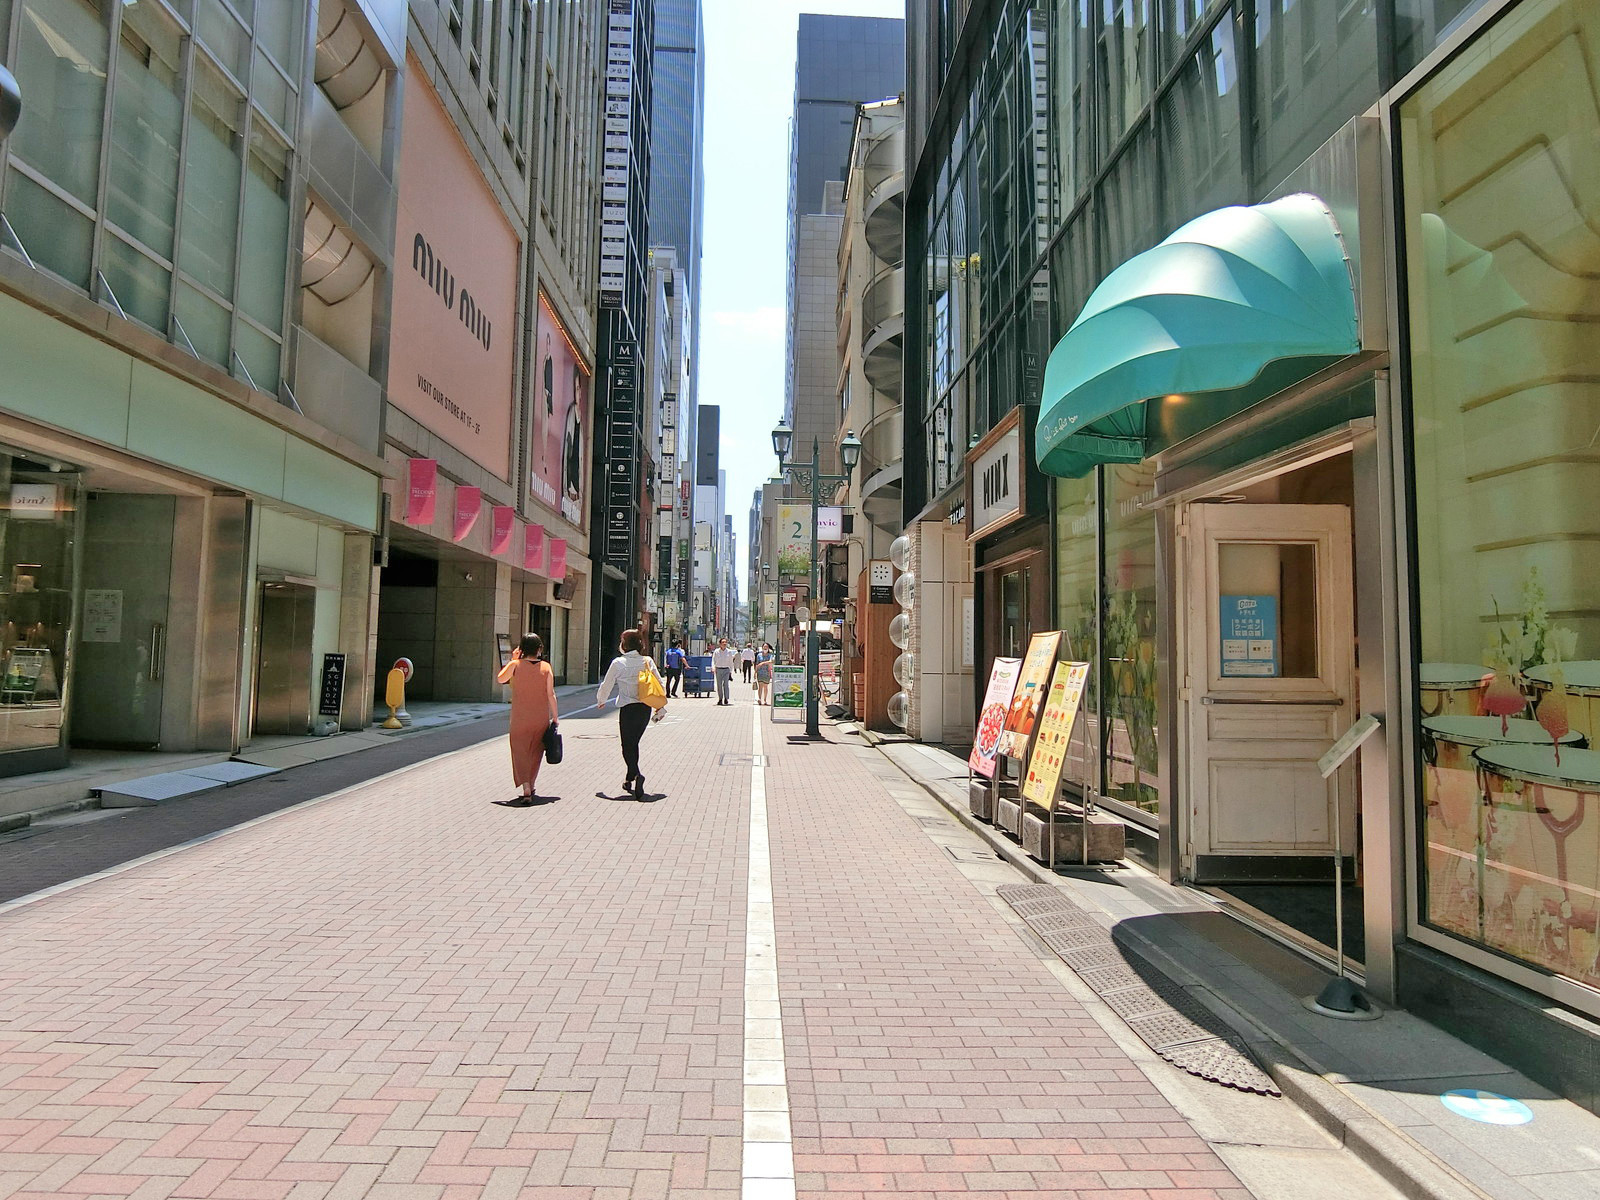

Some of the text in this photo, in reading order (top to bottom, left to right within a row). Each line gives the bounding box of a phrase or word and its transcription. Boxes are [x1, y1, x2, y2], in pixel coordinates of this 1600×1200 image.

[619, 346, 630, 355] M
[417, 373, 433, 397] VISIT
[432, 387, 444, 407] OUR
[444, 396, 460, 420] STORE
[459, 410, 466, 424] AT
[983, 452, 1009, 511] MINX
[791, 520, 803, 539] 2
[817, 518, 838, 527] nvic
[331, 674, 339, 704] GINZA
